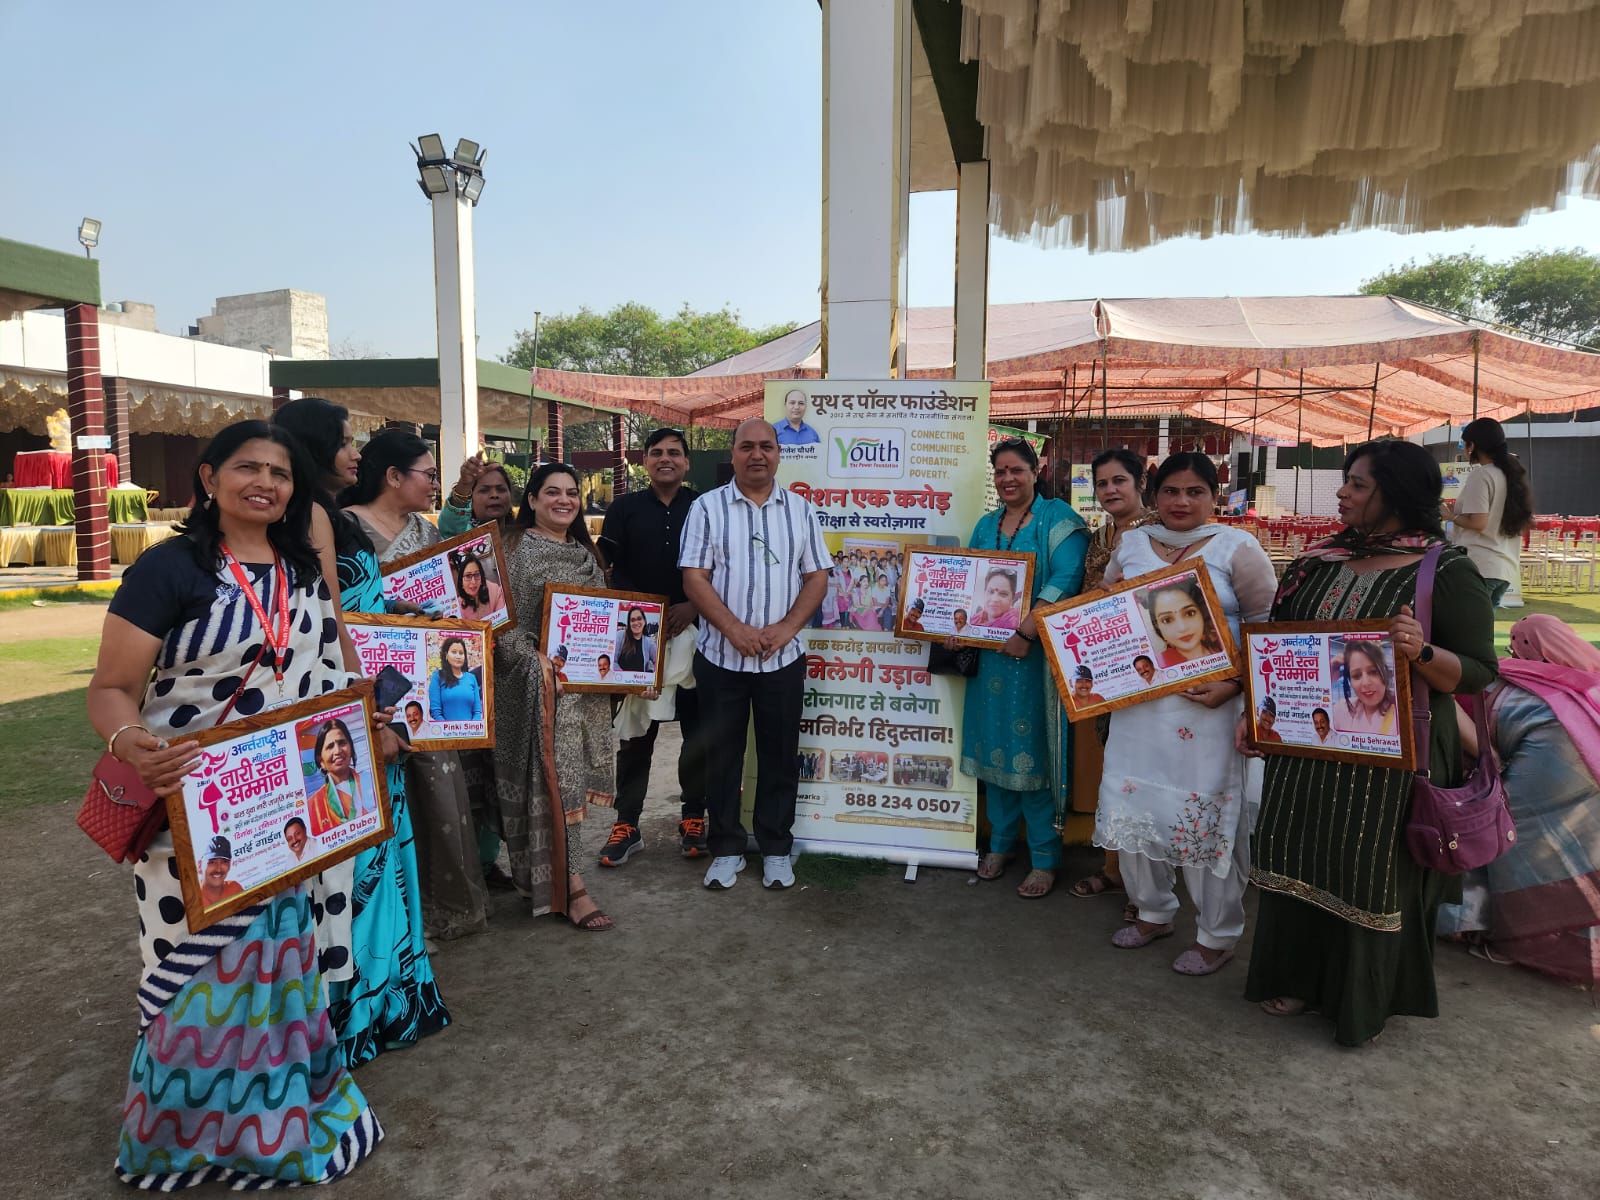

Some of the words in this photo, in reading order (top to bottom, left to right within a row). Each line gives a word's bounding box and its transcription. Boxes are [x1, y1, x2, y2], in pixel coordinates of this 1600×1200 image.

[811, 394, 837, 414] यूथ
[838, 395, 853, 410] द
[858, 389, 899, 411] पॉवर
[901, 390, 978, 411] फाउंडेशन
[912, 430, 965, 440] CONNECTING
[835, 437, 899, 468] Youth
[910, 456, 958, 466] COMBATING
[851, 489, 891, 508] एक
[894, 484, 952, 515] करोड़
[816, 511, 847, 529] शिक्षा
[849, 512, 861, 527] से
[928, 567, 946, 579] नारी
[947, 571, 967, 580] रत्न
[402, 579, 423, 598] नारी
[424, 574, 444, 589] रत्न
[408, 584, 446, 604] म्मान
[929, 579, 966, 590] सम्मान
[572, 609, 590, 623] नारी
[591, 614, 610, 624] रत्न
[1076, 616, 1102, 635] नारी
[1104, 613, 1129, 628] रत्न
[573, 622, 609, 635] सम्मान
[1082, 623, 1133, 647] सम्मान
[361, 643, 388, 660] नारी
[390, 650, 415, 661] रत्न
[808, 640, 829, 650] एक
[832, 638, 864, 655] करोड़
[866, 640, 901, 655] सपनों
[904, 641, 922, 655] को
[1180, 661, 1200, 672] Pinki
[1200, 655, 1227, 667] Kumari
[1272, 650, 1294, 667] नारी
[1296, 656, 1319, 667] रत्न
[878, 664, 932, 690] उड़ान
[1275, 667, 1319, 681] सम्मान
[804, 688, 866, 710] रोजगार
[869, 691, 886, 711] से
[889, 692, 941, 714] बनेगा
[464, 723, 483, 732] Singh
[868, 718, 953, 747] हिंदुस्तान!
[1352, 735, 1365, 744] Anju
[1368, 736, 1399, 746] Sehrawat
[219, 758, 253, 787] नारी
[255, 754, 287, 776] रत्न
[226, 769, 288, 806] सम्मान
[846, 793, 877, 808] 888
[881, 795, 912, 810] 234
[917, 798, 960, 814] 0507
[321, 828, 347, 845] Indra
[350, 815, 377, 832] Dubey
